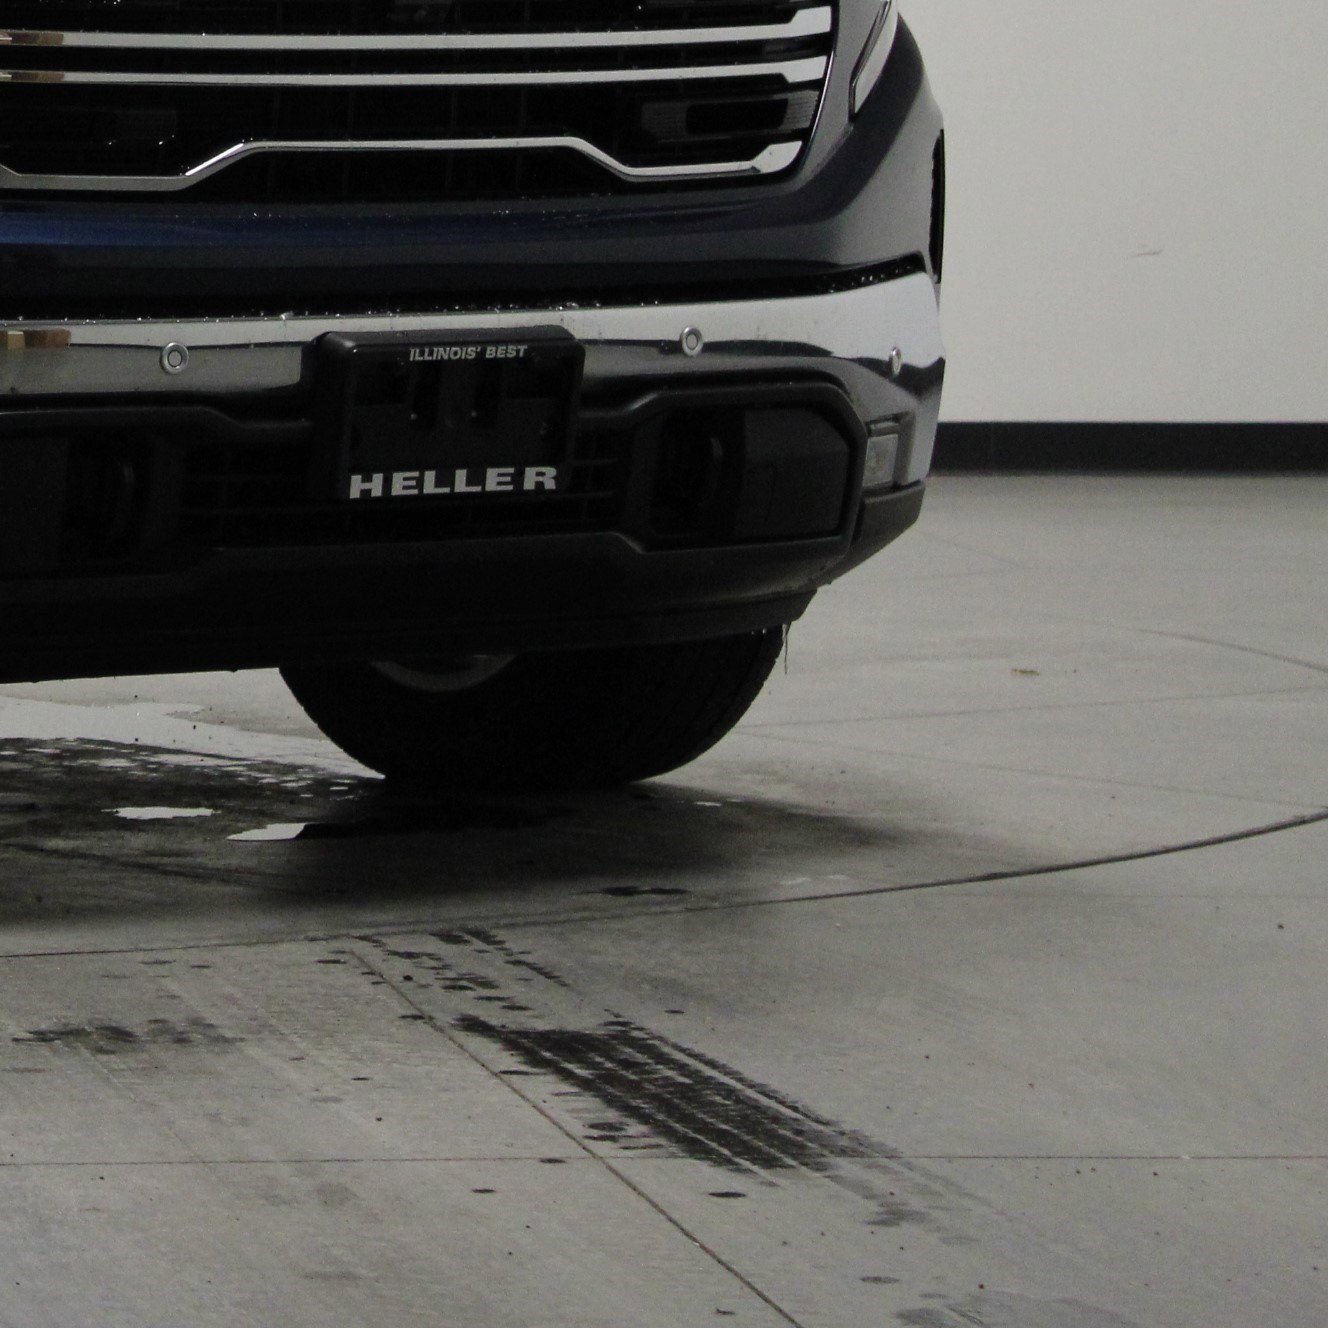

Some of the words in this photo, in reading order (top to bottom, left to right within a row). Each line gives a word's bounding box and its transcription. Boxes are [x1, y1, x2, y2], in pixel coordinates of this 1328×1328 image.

[409, 346, 482, 362] ILLINOIS'
[485, 345, 528, 359] BEST
[349, 466, 557, 499] HELLER
